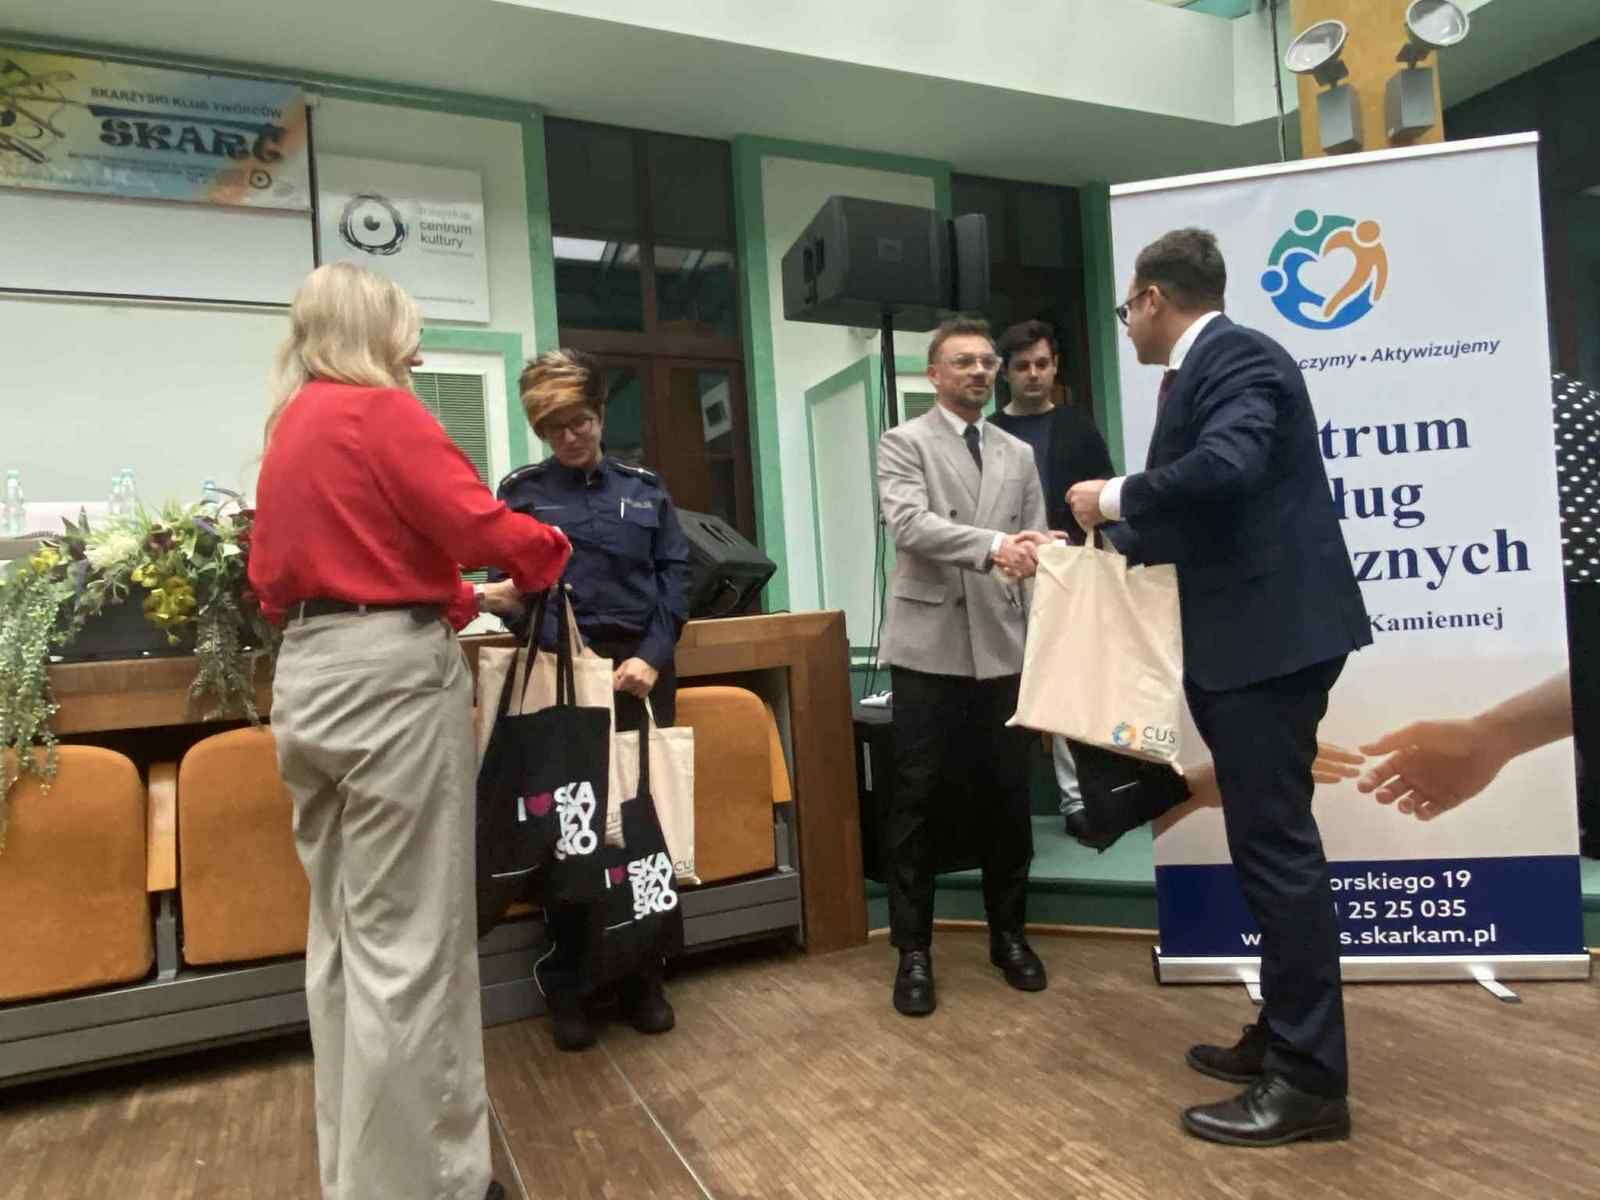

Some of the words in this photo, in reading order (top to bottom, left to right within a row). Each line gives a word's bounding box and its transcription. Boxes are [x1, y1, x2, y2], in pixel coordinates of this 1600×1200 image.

[420, 222, 472, 236] centrum
[420, 232, 463, 249] kultury
[1297, 352, 1357, 371] czymy
[1370, 339, 1501, 364] Aktywizujemy
[1317, 416, 1472, 460] trum
[1328, 476, 1426, 529] ług
[1353, 528, 1532, 591] znych
[1142, 725, 1177, 744] CUS
[1329, 871, 1436, 893] orskiego
[1442, 869, 1472, 888] 19
[1348, 901, 1377, 920] 25
[1384, 900, 1414, 919] 25
[1420, 899, 1467, 918] 035
